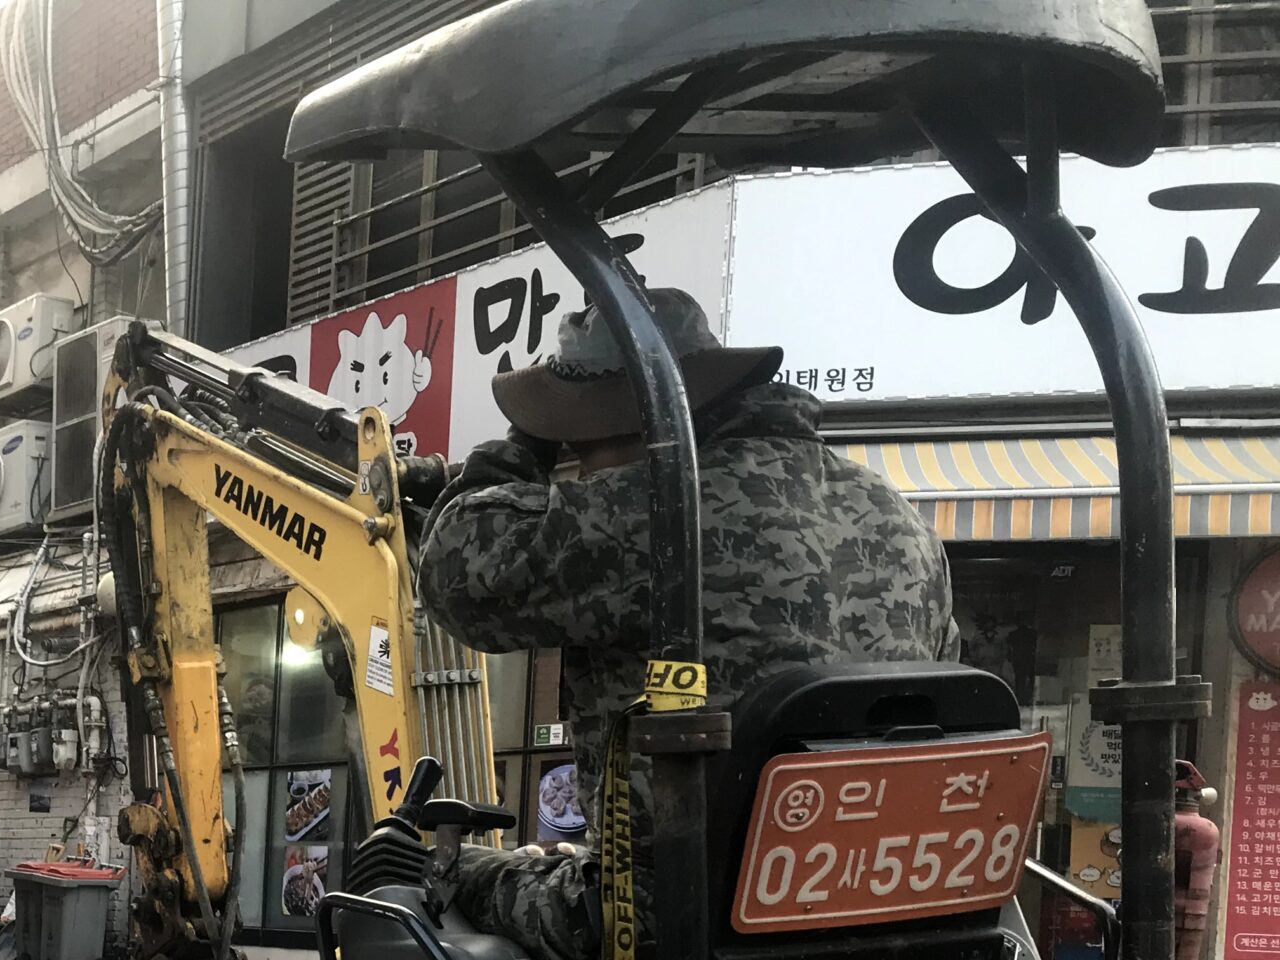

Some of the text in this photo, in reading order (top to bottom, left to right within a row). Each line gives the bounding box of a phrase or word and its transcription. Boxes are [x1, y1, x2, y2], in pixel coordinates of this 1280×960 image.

[773, 366, 875, 392] 이태원점
[214, 463, 327, 561] YANMAR
[1051, 566, 1074, 577] ADT
[756, 824, 1020, 905] 02사5528
